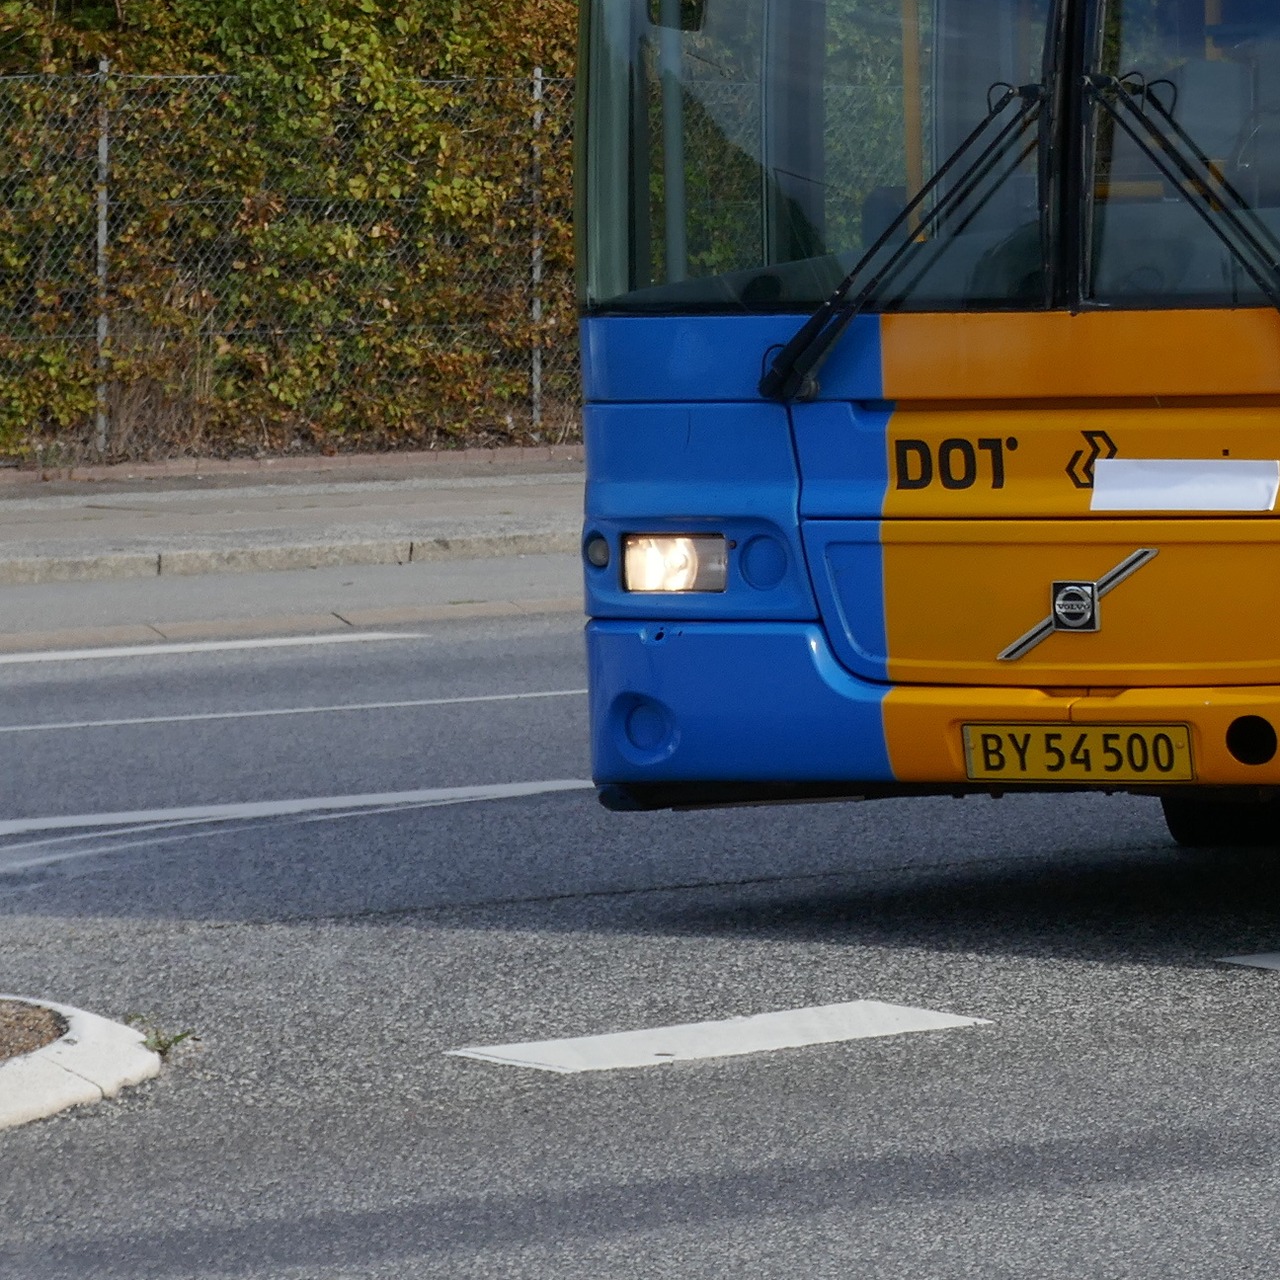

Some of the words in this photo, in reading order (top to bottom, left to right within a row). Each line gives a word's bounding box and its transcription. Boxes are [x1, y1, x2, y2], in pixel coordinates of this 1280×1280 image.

[894, 435, 1019, 491] DOT
[982, 733, 1031, 772] BY
[1043, 733, 1092, 772] 54
[1102, 732, 1175, 772] 500
